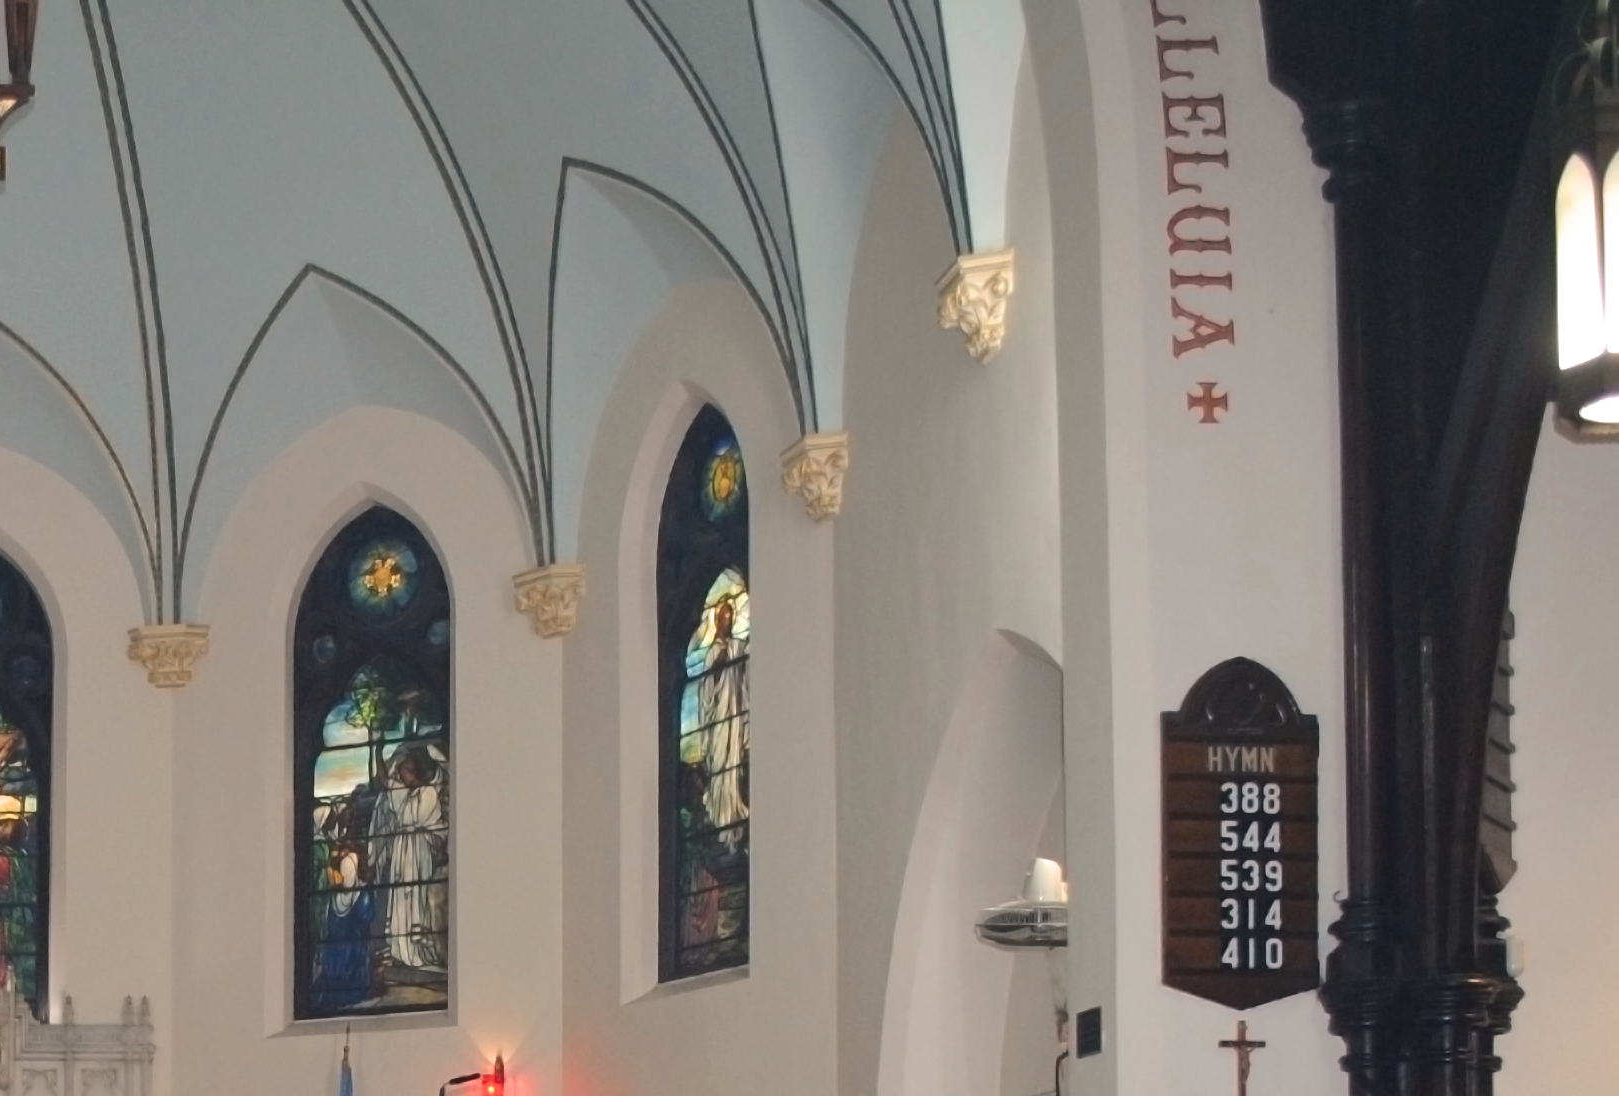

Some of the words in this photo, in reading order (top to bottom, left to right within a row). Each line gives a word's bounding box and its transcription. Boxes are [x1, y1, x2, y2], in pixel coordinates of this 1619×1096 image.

[1207, 746, 1275, 772] HYMN
[1220, 782, 1281, 814] 388
[1220, 821, 1281, 852] 544
[1220, 859, 1283, 892] 539
[1221, 898, 1282, 930] 314
[1221, 937, 1283, 969] 410
